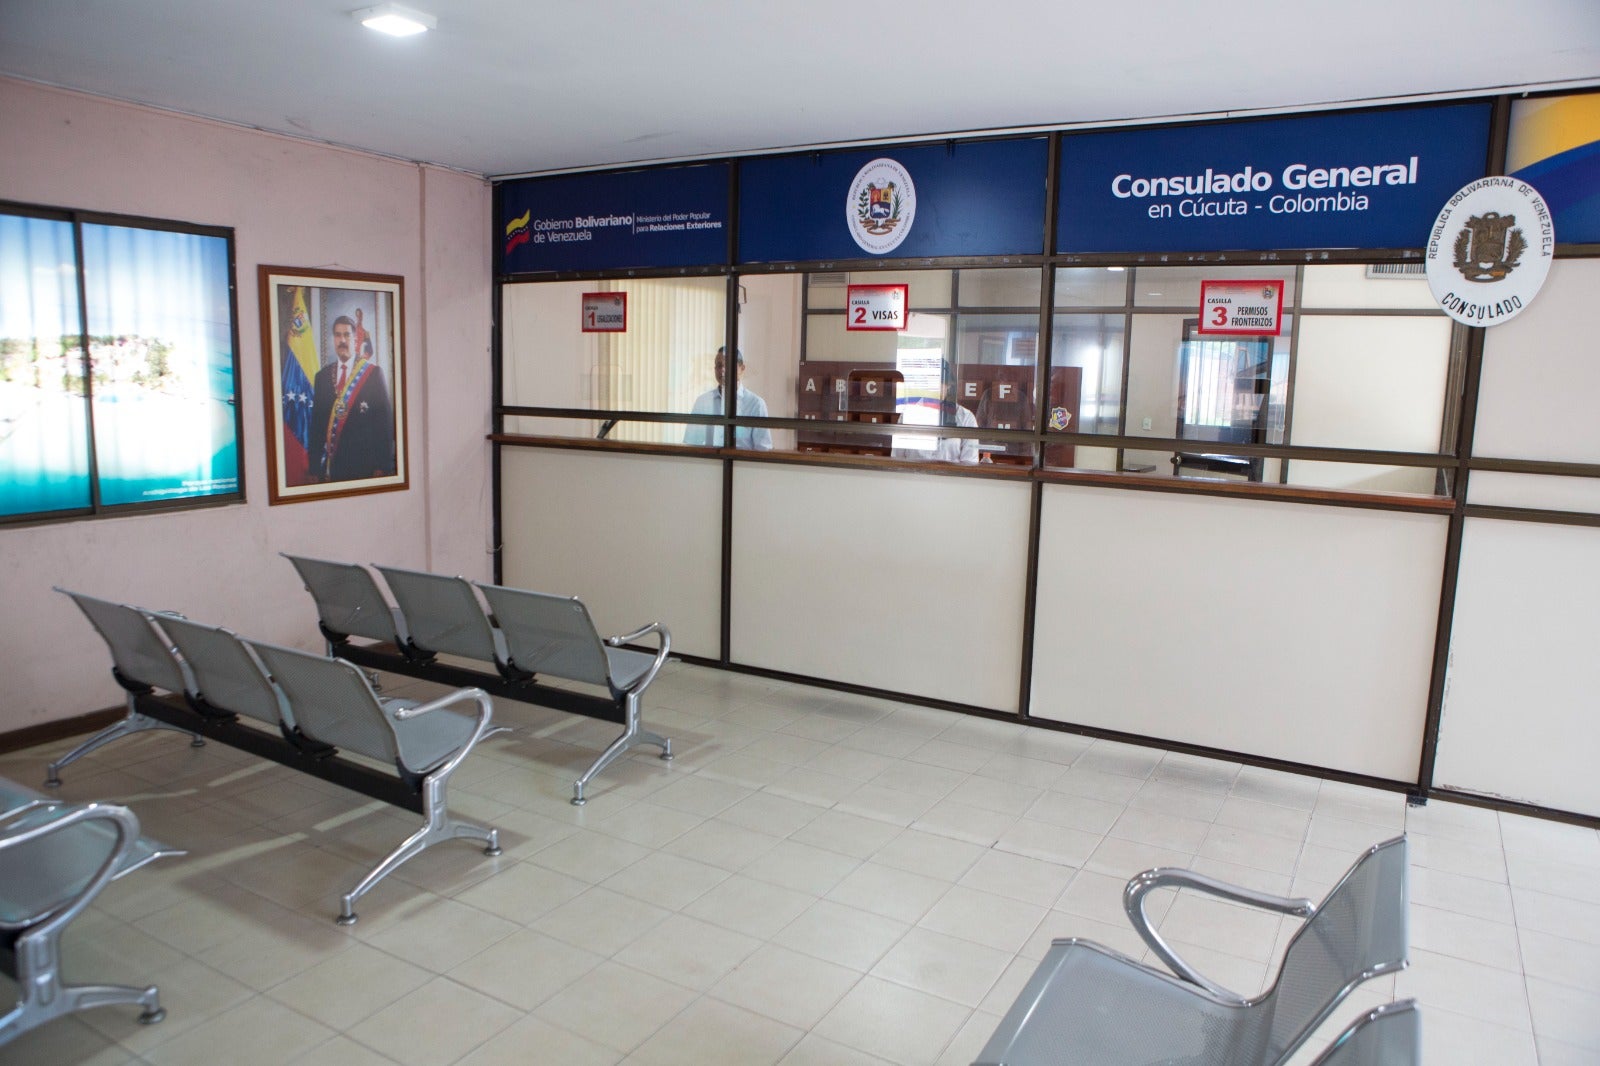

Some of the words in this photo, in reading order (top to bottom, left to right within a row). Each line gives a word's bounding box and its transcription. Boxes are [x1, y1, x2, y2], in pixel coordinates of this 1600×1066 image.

[1111, 166, 1273, 199] Consulado
[1282, 156, 1419, 190] General
[1148, 202, 1172, 218] en
[1178, 197, 1248, 217] Cúcuta
[1269, 192, 1369, 214] Colombia
[534, 219, 574, 231] Gobierno
[575, 214, 632, 228] Bolivariano
[649, 223, 685, 232] Relaciones
[686, 221, 722, 230] Exteriores
[1428, 208, 1453, 260] REPUBLICA
[1449, 177, 1515, 207] BOLIVARIANA
[1518, 184, 1533, 197] DE
[1531, 197, 1551, 257] VENEZUELA
[533, 232, 545, 243] de
[547, 230, 592, 242] Venezuela
[854, 306, 867, 324] 2
[872, 310, 898, 320] VISAS
[1237, 306, 1268, 316] PERMISOS
[1441, 292, 1523, 320] CONSULADO
[588, 311, 595, 327] 1
[1211, 306, 1228, 327] 3
[1231, 317, 1273, 327] FRONTERIZOS
[805, 378, 816, 392] A
[835, 379, 846, 393] B
[865, 380, 878, 394] C
[964, 382, 977, 397] E
[999, 384, 1012, 399] F
